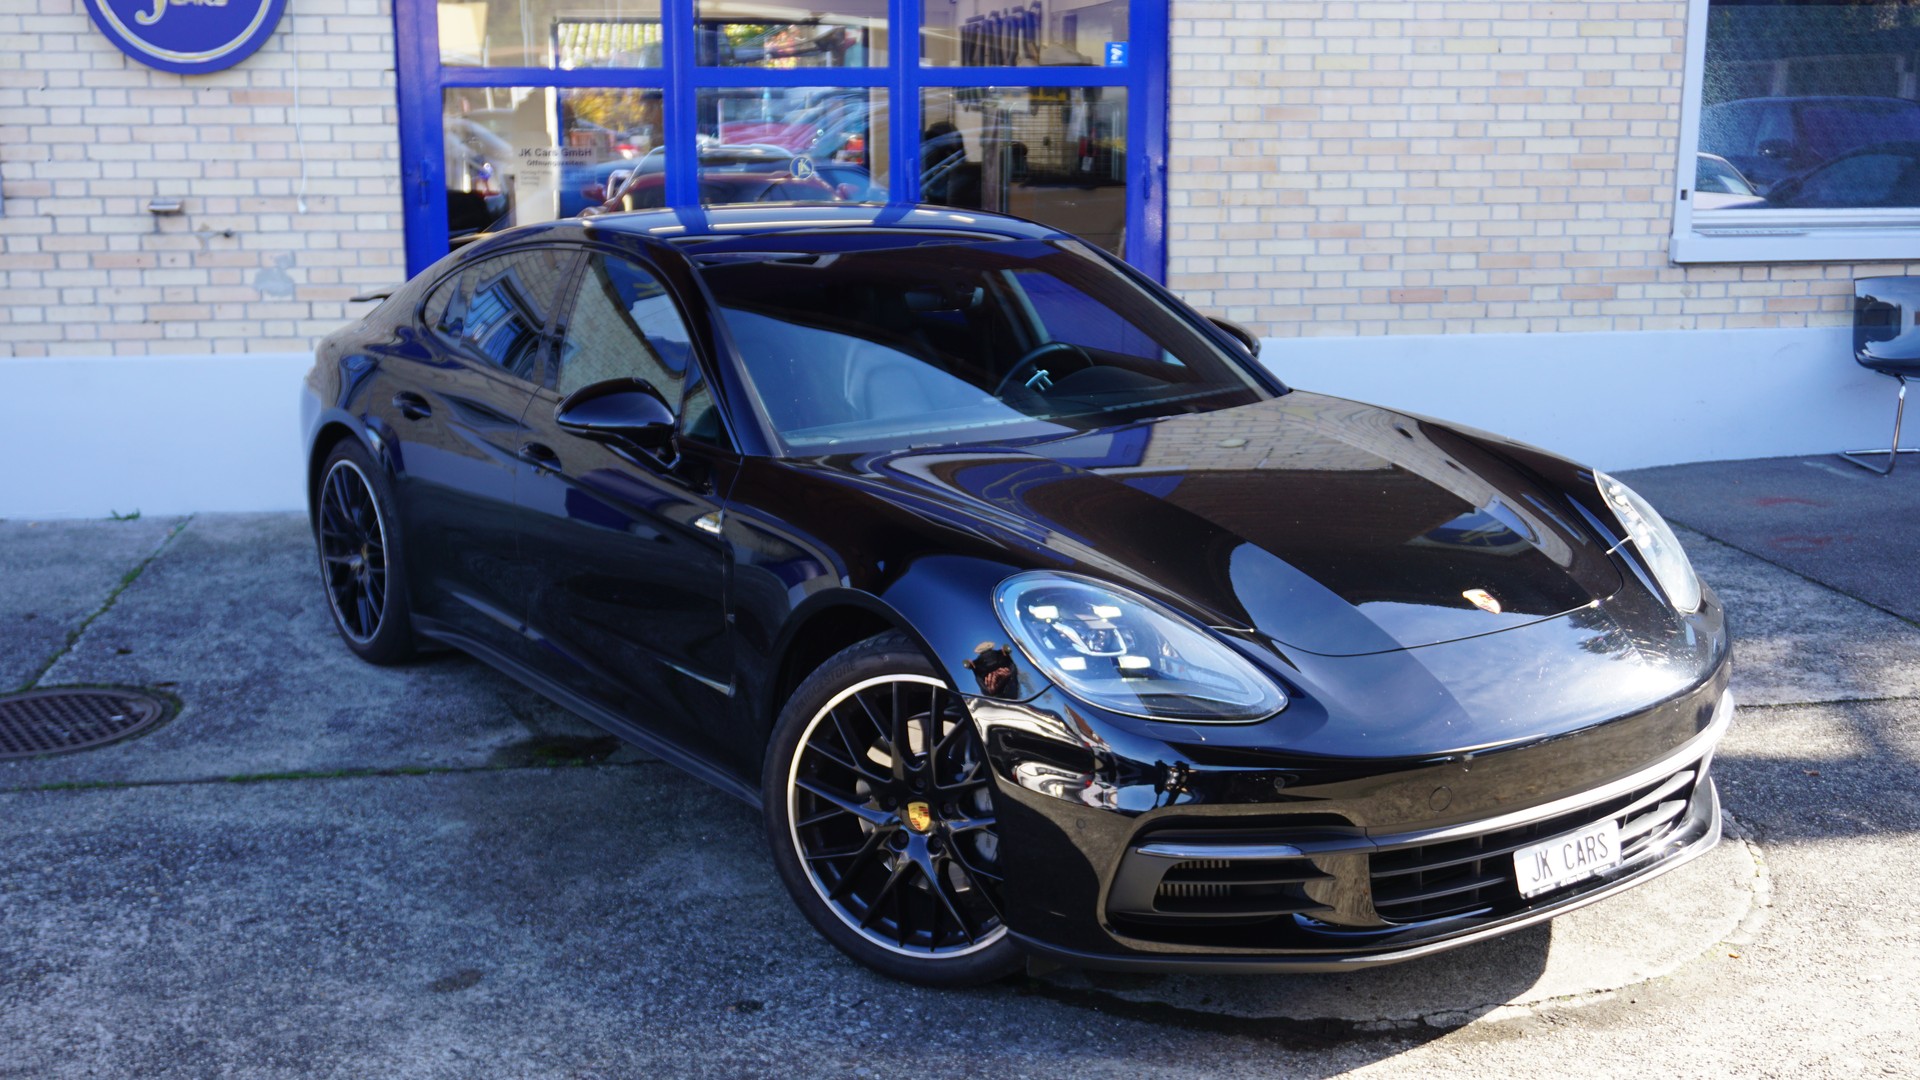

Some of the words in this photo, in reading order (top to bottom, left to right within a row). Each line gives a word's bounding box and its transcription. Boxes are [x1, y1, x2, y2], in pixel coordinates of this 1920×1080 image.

[518, 148, 532, 157] JK
[562, 148, 592, 157] GmbH
[1531, 849, 1553, 882] JK
[1562, 832, 1609, 870] CARS
